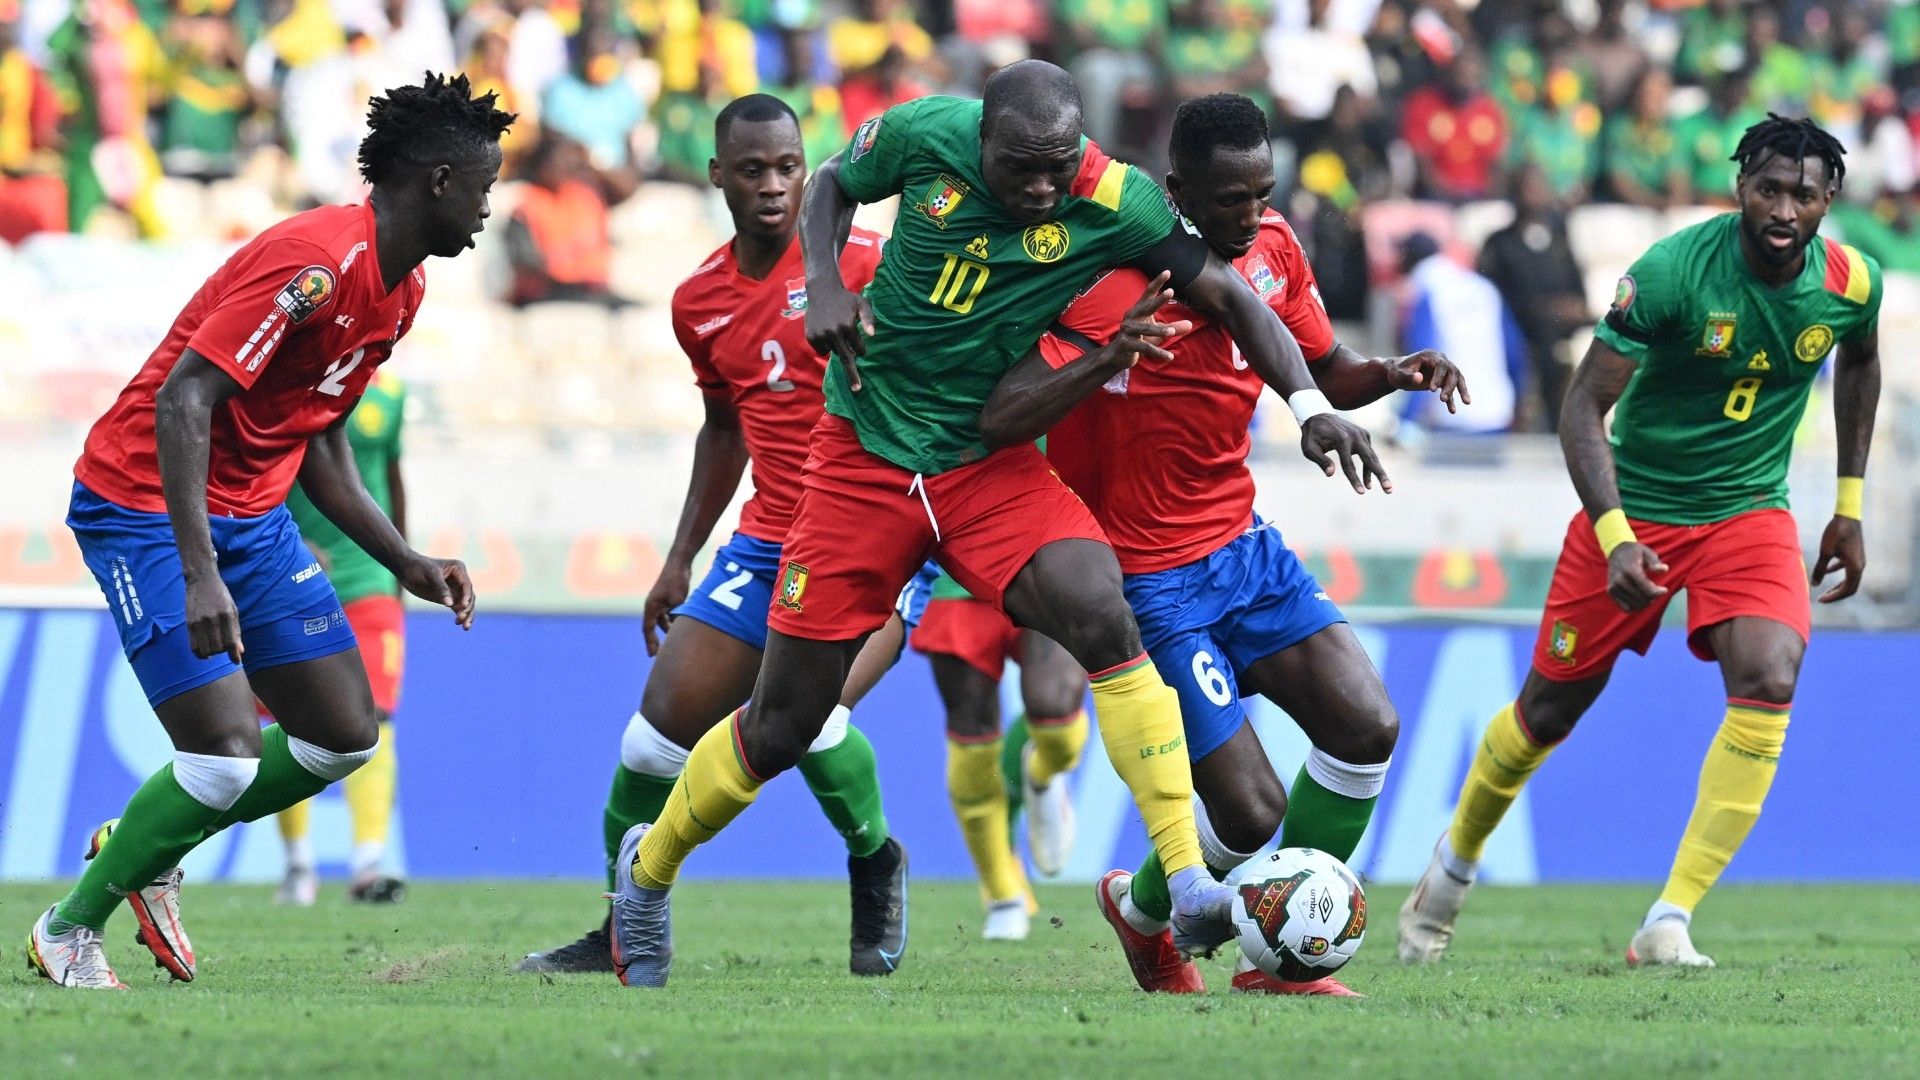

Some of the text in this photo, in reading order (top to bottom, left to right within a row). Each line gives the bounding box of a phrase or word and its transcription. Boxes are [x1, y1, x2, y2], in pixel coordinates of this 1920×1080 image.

[929, 253, 990, 314] 10
[308, 347, 365, 397] 2
[762, 340, 796, 392] 2
[1724, 377, 1763, 422] 8
[708, 561, 754, 611] 2
[1191, 650, 1231, 707] 6
[1139, 745, 1155, 759] LE
[1309, 888, 1317, 919] umbro
